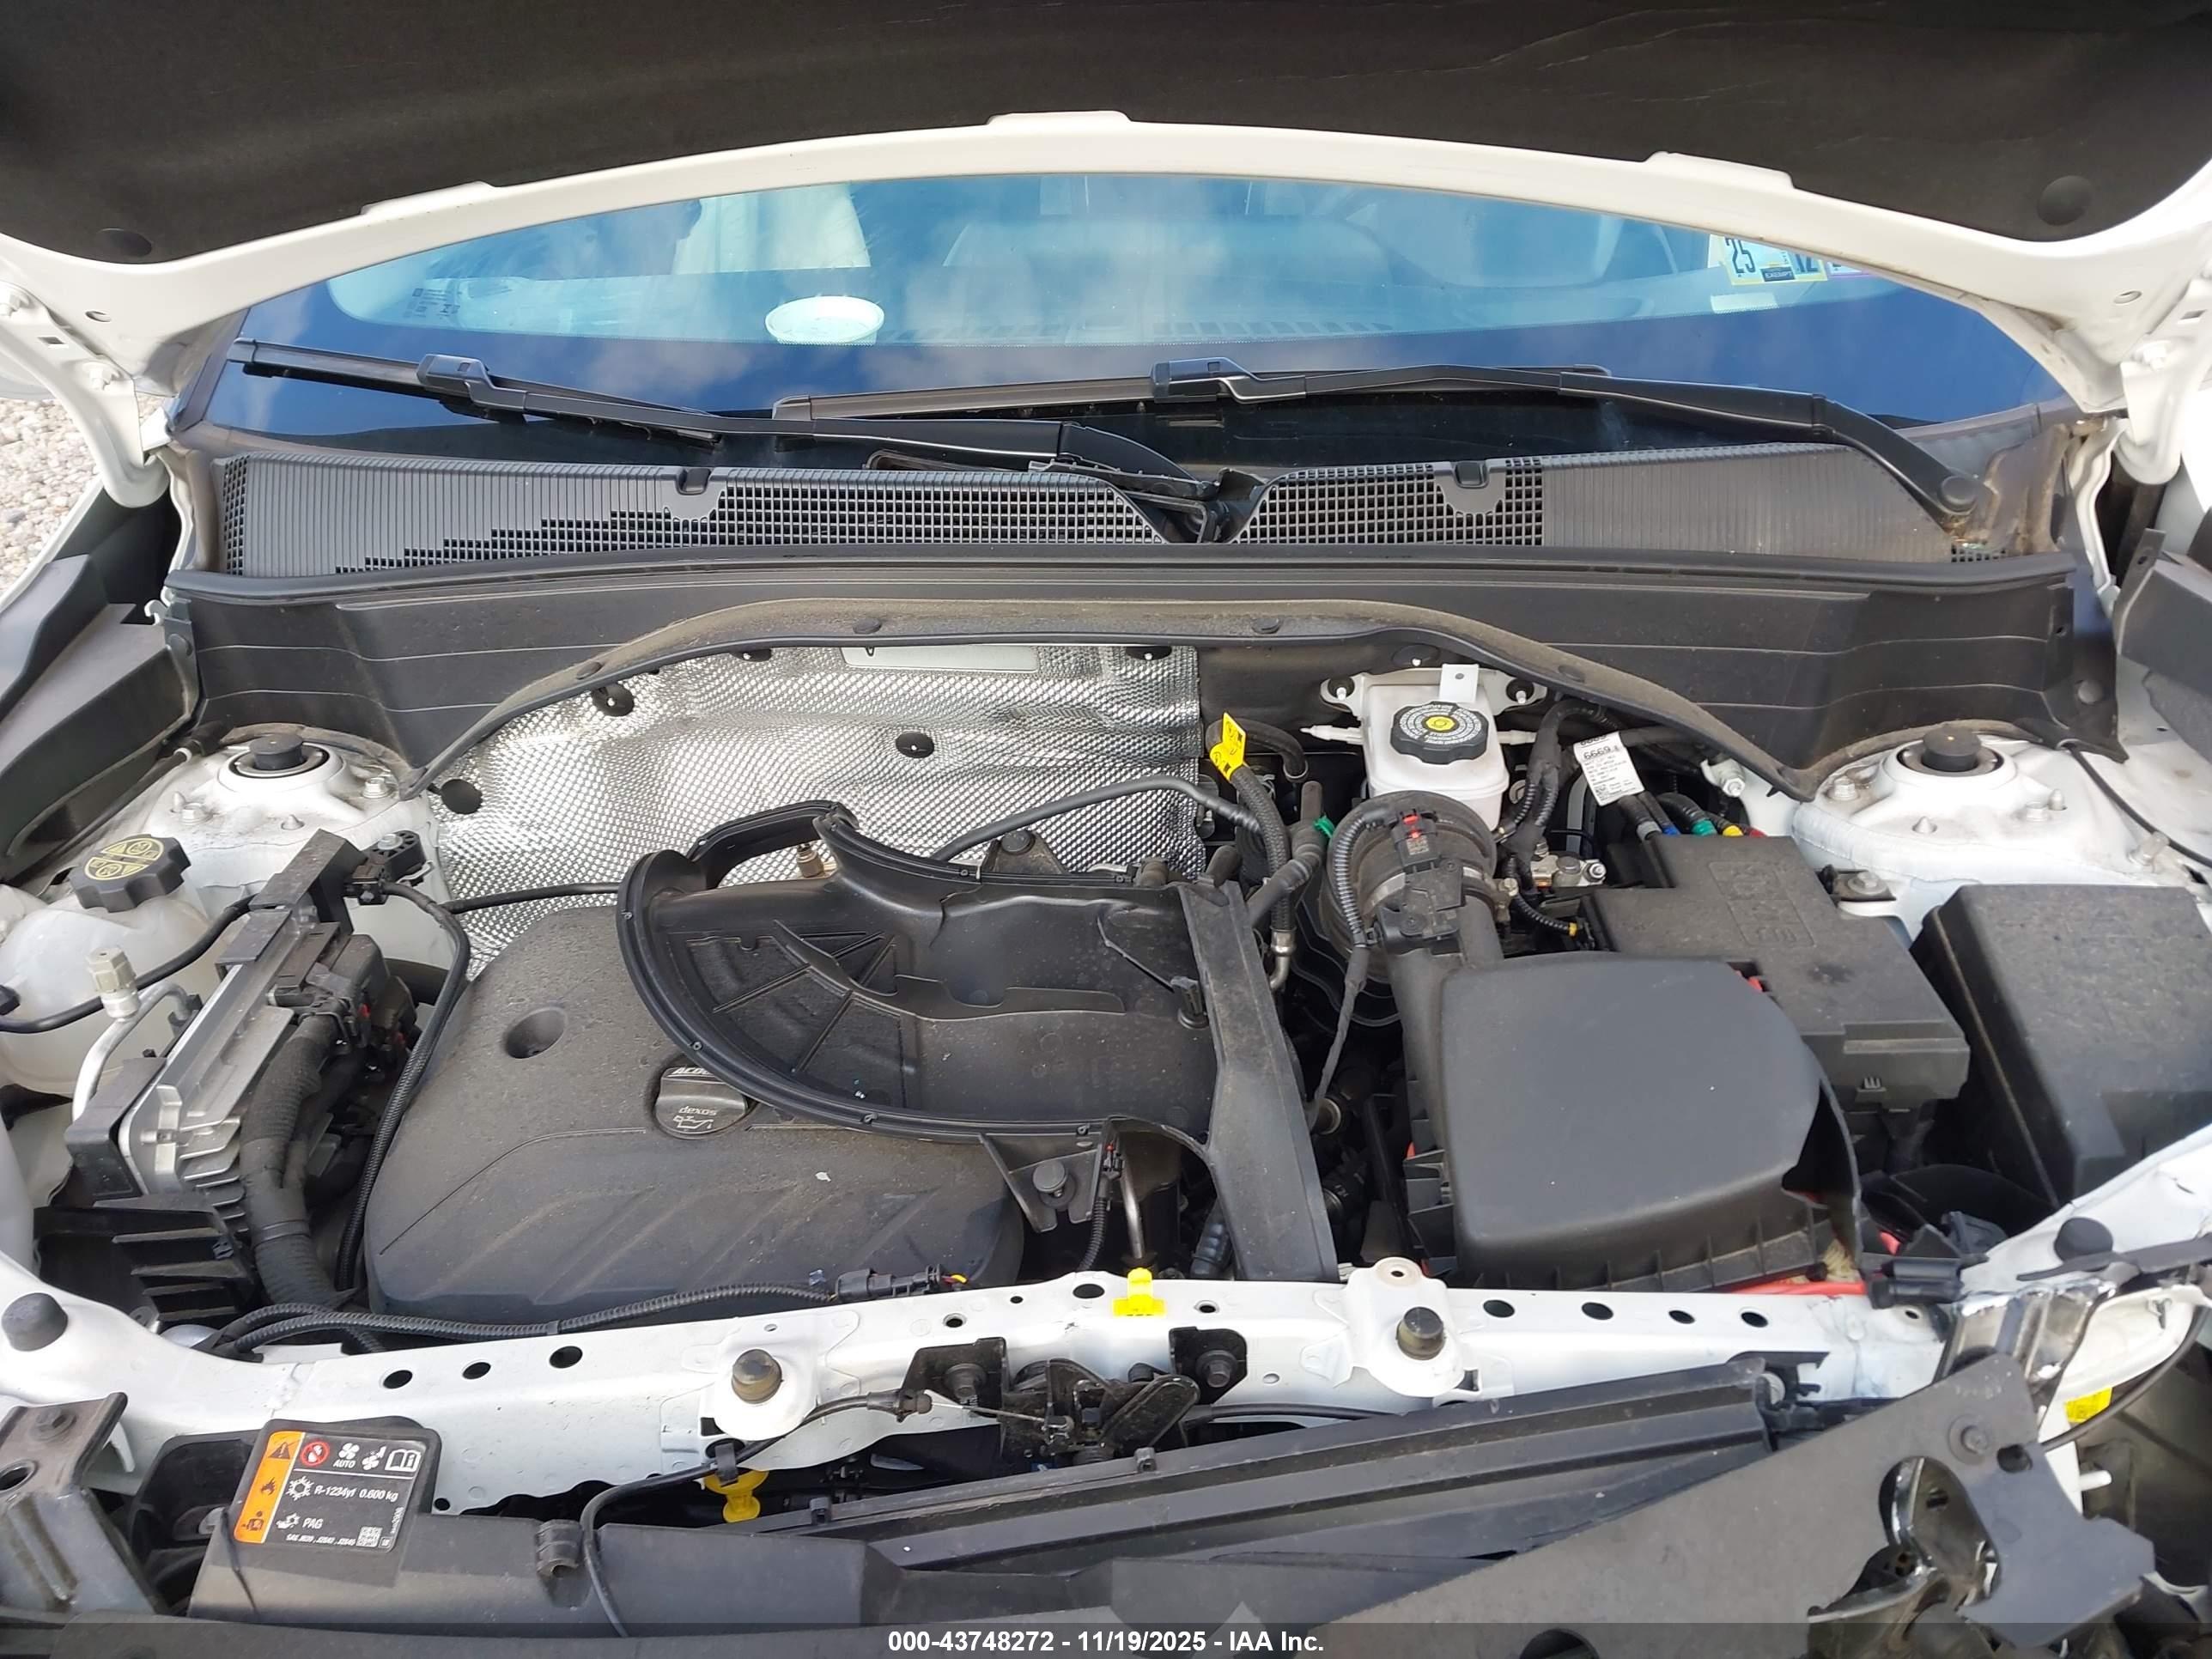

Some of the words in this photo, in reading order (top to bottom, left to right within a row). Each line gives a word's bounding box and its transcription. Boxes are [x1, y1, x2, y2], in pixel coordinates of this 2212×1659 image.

[1583, 745, 1611, 759] 6669
[678, 1105, 716, 1115] dexos
[333, 1459, 356, 1468] AUTO
[359, 1488, 386, 1499] 0.600
[386, 1491, 398, 1502] kg
[302, 1517, 324, 1528] PAG
